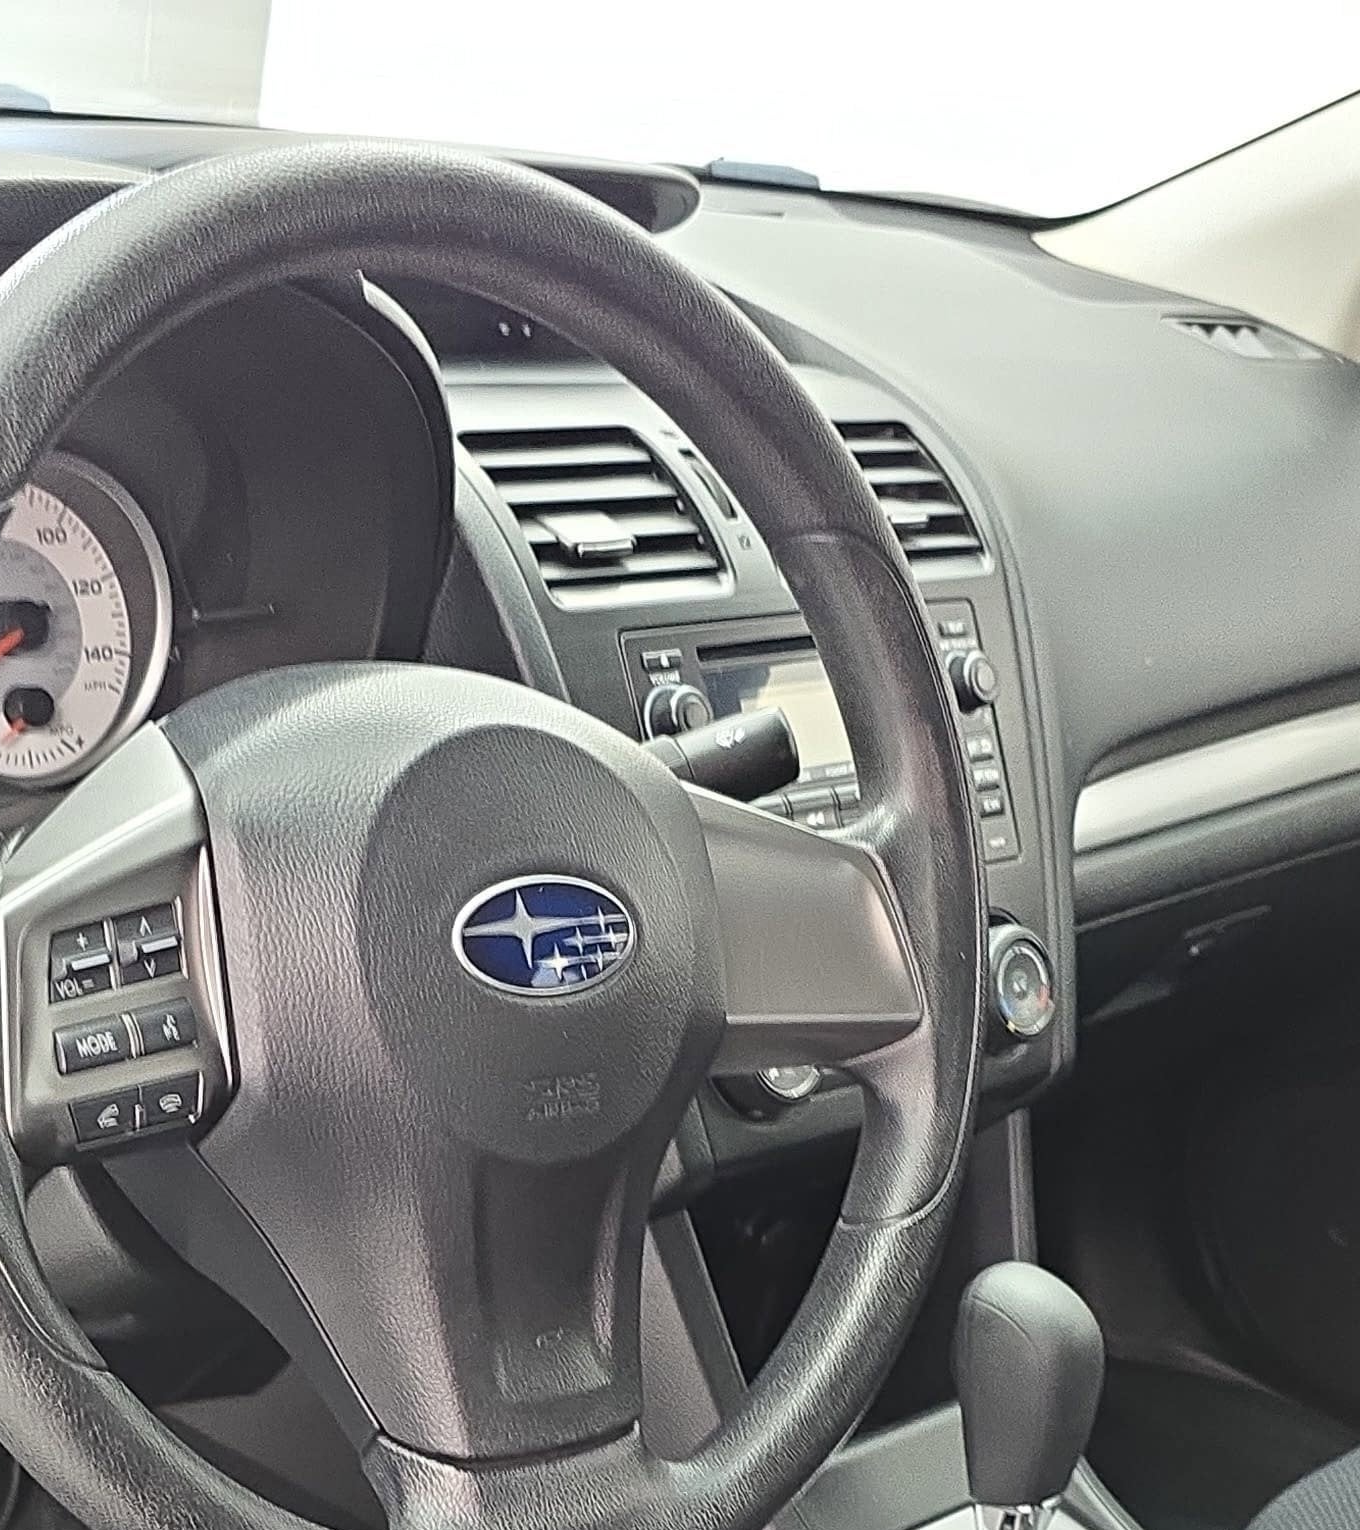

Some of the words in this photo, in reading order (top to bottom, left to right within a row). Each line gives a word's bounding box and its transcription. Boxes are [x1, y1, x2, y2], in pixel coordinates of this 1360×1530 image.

[36, 528, 68, 546] 100
[72, 579, 103, 596] 120
[84, 646, 114, 665] 140
[55, 977, 84, 1000] VOL
[76, 1031, 118, 1058] MODE
